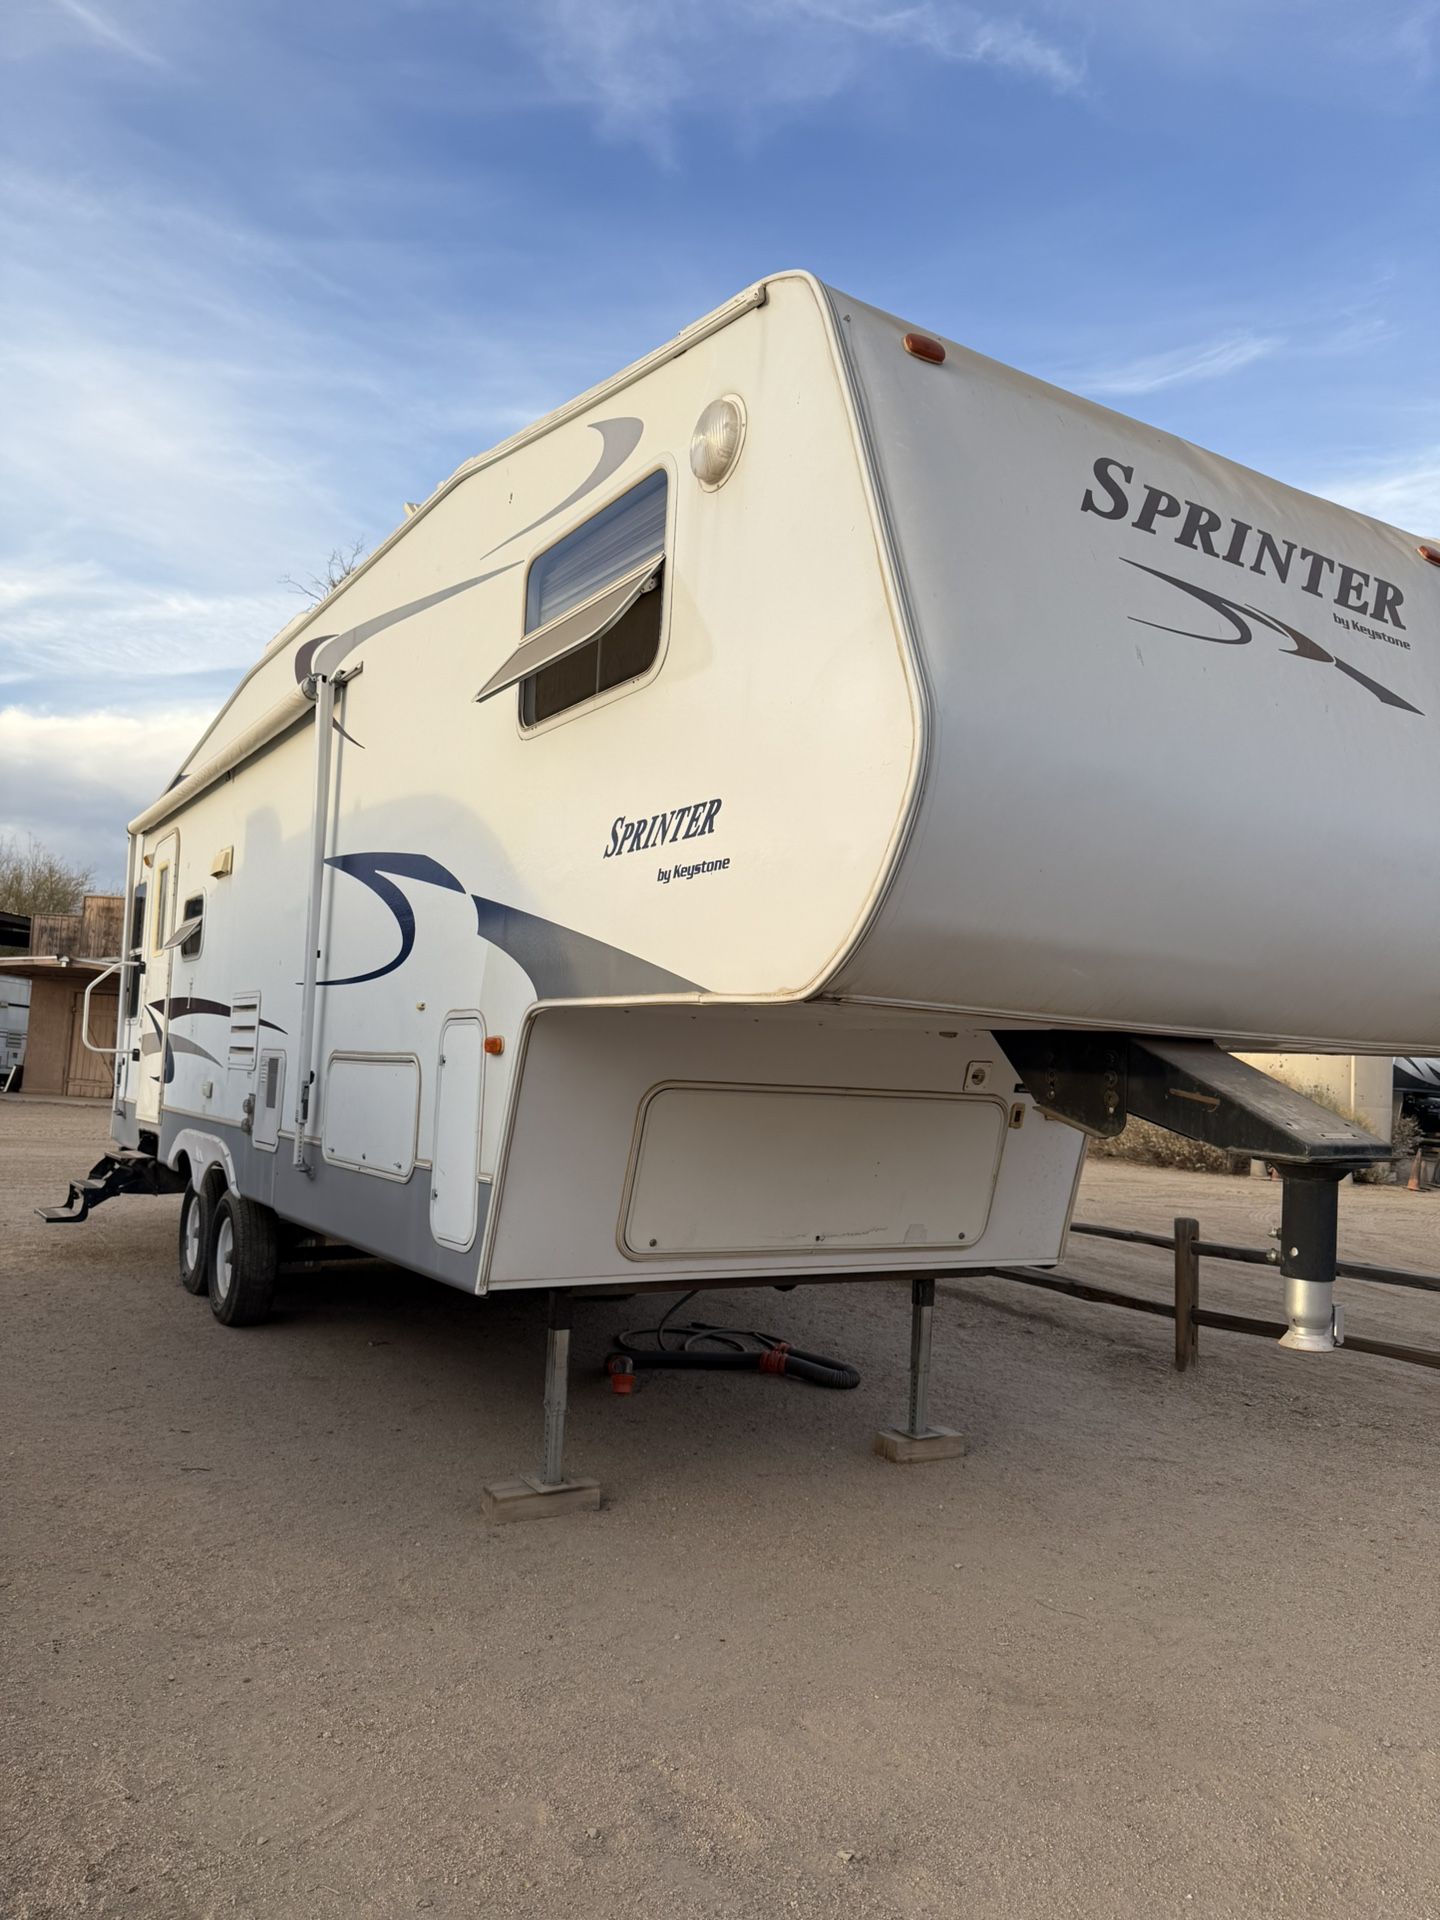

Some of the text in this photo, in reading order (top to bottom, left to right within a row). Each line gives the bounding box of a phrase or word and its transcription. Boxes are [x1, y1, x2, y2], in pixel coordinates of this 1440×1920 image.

[1080, 457, 1407, 630] SPRINTER
[1333, 612, 1411, 650] by Keystone
[603, 798, 722, 859] SPRINTER
[657, 858, 730, 884] by Keystone
